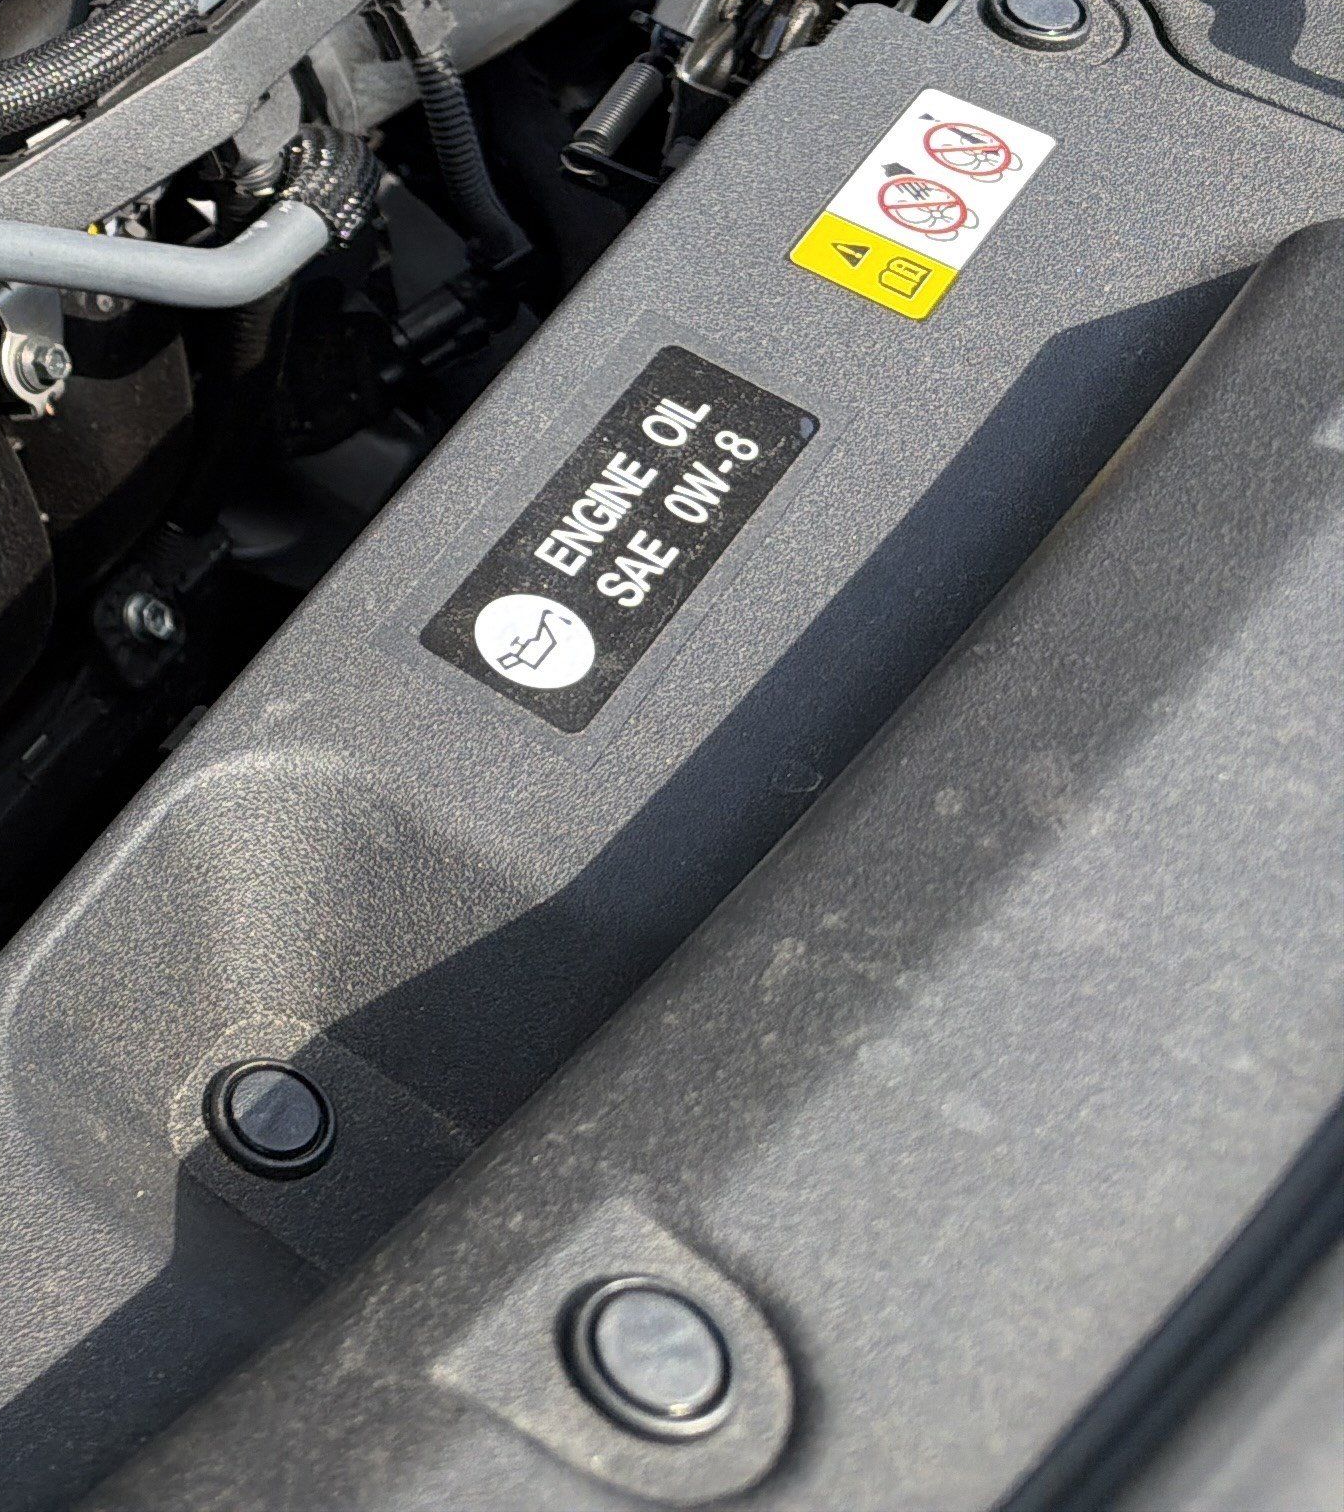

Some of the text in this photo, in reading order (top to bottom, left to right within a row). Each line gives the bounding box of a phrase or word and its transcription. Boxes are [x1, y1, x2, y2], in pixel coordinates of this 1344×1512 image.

[534, 397, 711, 577] ENGINE OIL
[597, 429, 760, 608] SAE 0W-8
